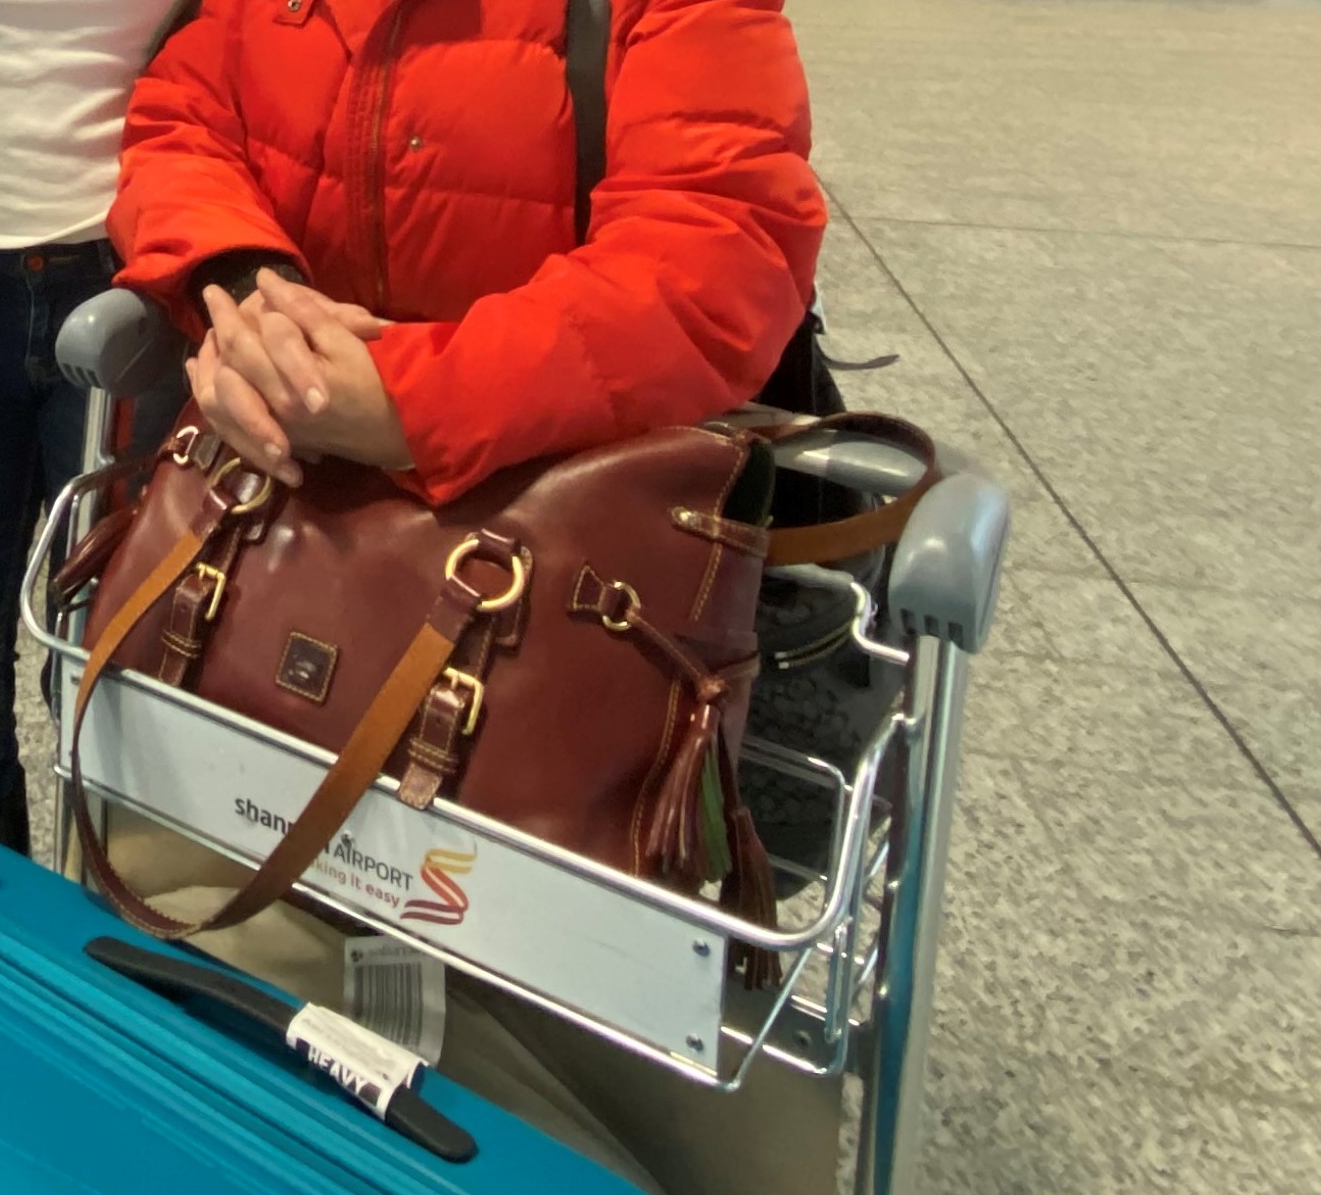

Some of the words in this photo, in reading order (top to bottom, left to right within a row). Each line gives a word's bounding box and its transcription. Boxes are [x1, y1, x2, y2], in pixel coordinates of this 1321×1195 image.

[312, 861, 347, 884] king
[351, 874, 361, 889] it
[366, 884, 400, 908] easy
[334, 840, 413, 891] AIRPORT
[307, 1046, 366, 1094] HEAVY
